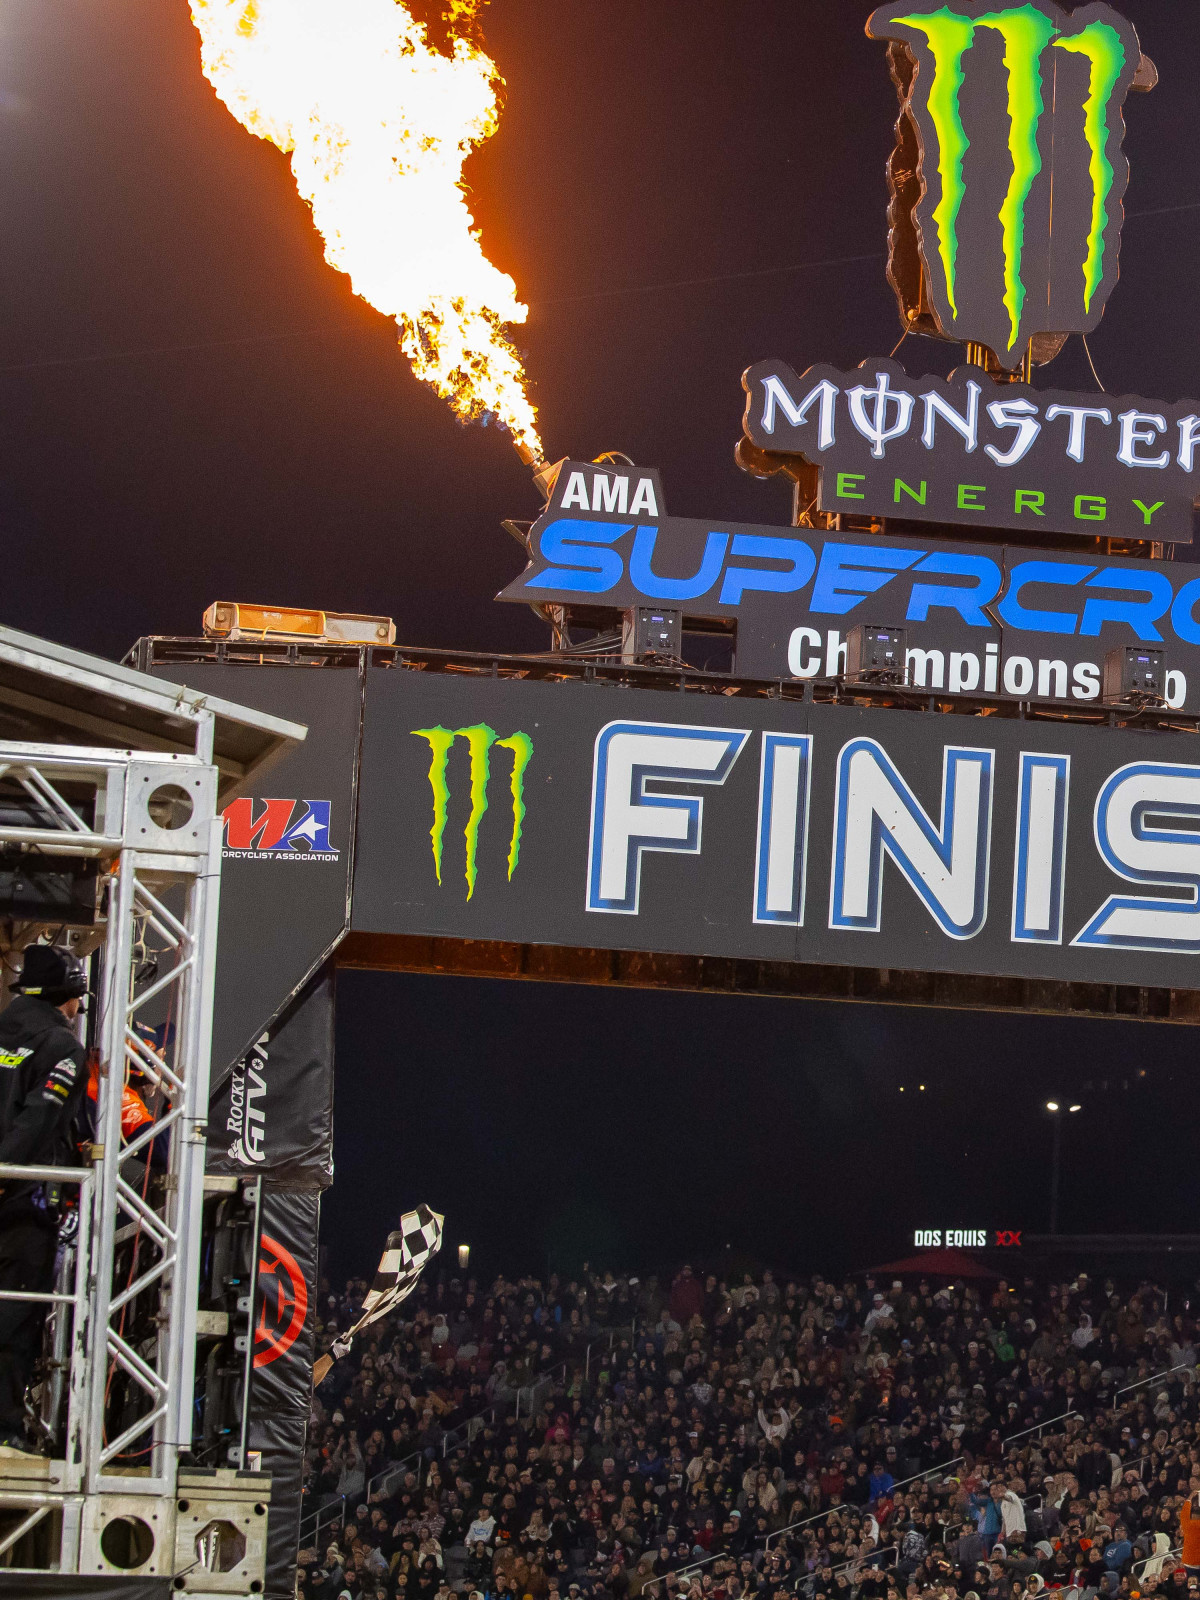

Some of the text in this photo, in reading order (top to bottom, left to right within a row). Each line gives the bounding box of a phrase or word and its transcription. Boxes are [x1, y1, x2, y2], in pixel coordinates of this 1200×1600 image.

[560, 471, 660, 517] AMA
[837, 472, 1166, 526] ENERGY
[788, 626, 1187, 710] Chmpionsp
[220, 797, 340, 853] MA
[222, 850, 339, 862] ORCYCLIST ASSOCIATION
[226, 1071, 245, 1136] ROCKY
[914, 1229, 1022, 1248] DOS EQUIS XX
